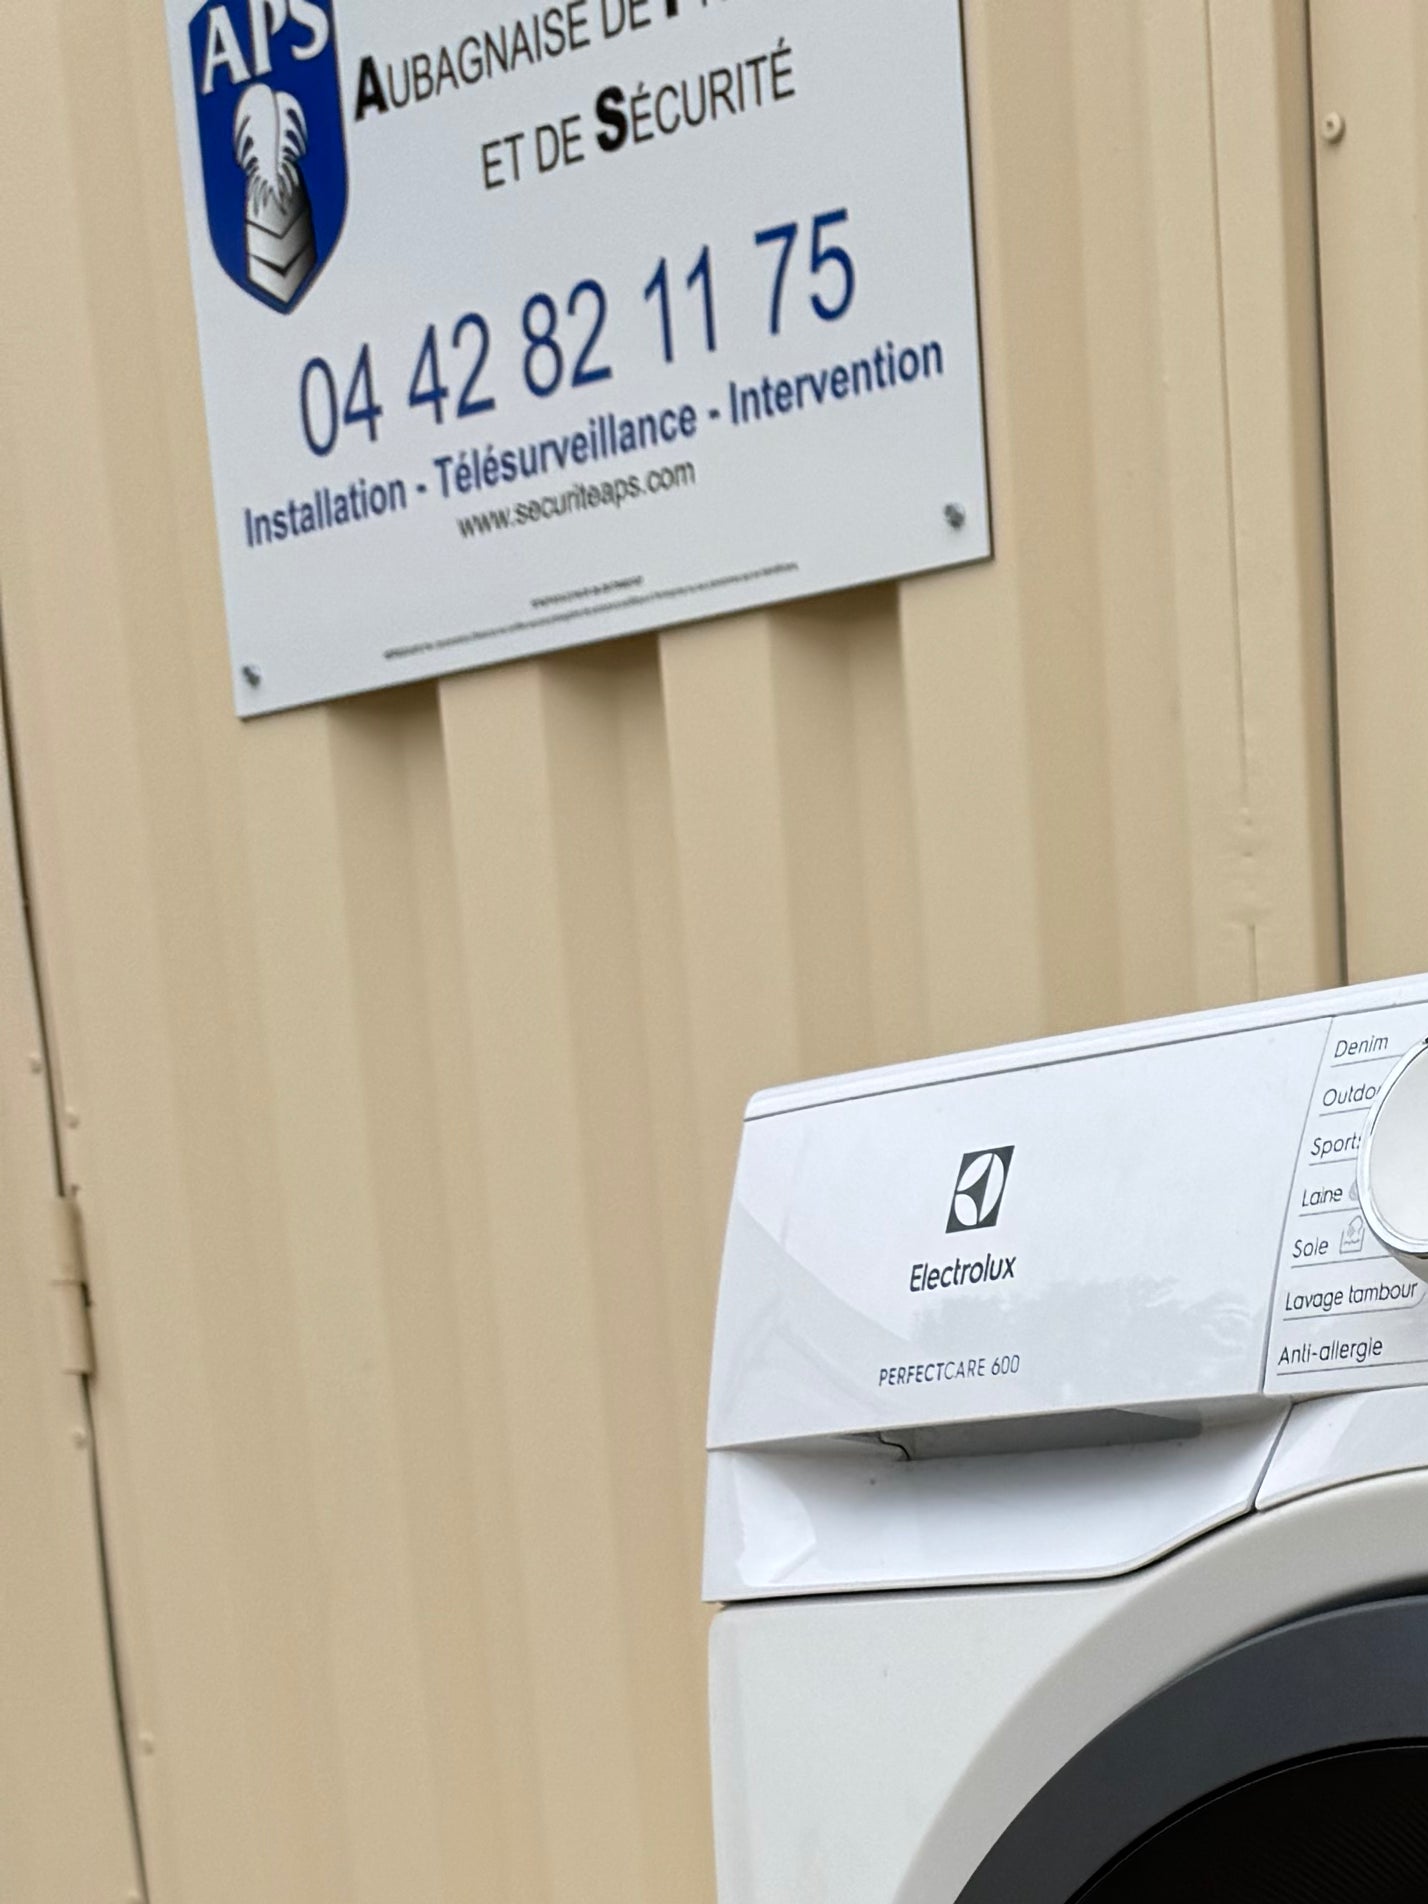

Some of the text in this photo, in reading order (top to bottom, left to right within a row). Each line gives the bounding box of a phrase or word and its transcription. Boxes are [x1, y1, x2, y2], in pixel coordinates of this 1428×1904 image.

[202, 0, 330, 96] APS
[355, 0, 592, 123] AUBAGNAISE
[481, 36, 796, 191] ET DE SÉCURITÉ
[298, 207, 856, 458] 04 42 82 11 75
[243, 478, 409, 548] Installation
[432, 403, 699, 499] Télésurveillance
[728, 340, 945, 426] Intervention
[456, 459, 696, 541] www.securiteaps.com
[1333, 1033, 1390, 1060] Denim
[1301, 1185, 1345, 1208] Laine
[909, 1252, 1017, 1293] Electrolux
[1285, 1281, 1420, 1312] Lavage tambour
[878, 1354, 1021, 1388] PERFECTCARE 600
[1277, 1337, 1384, 1367] Anti-allergie
